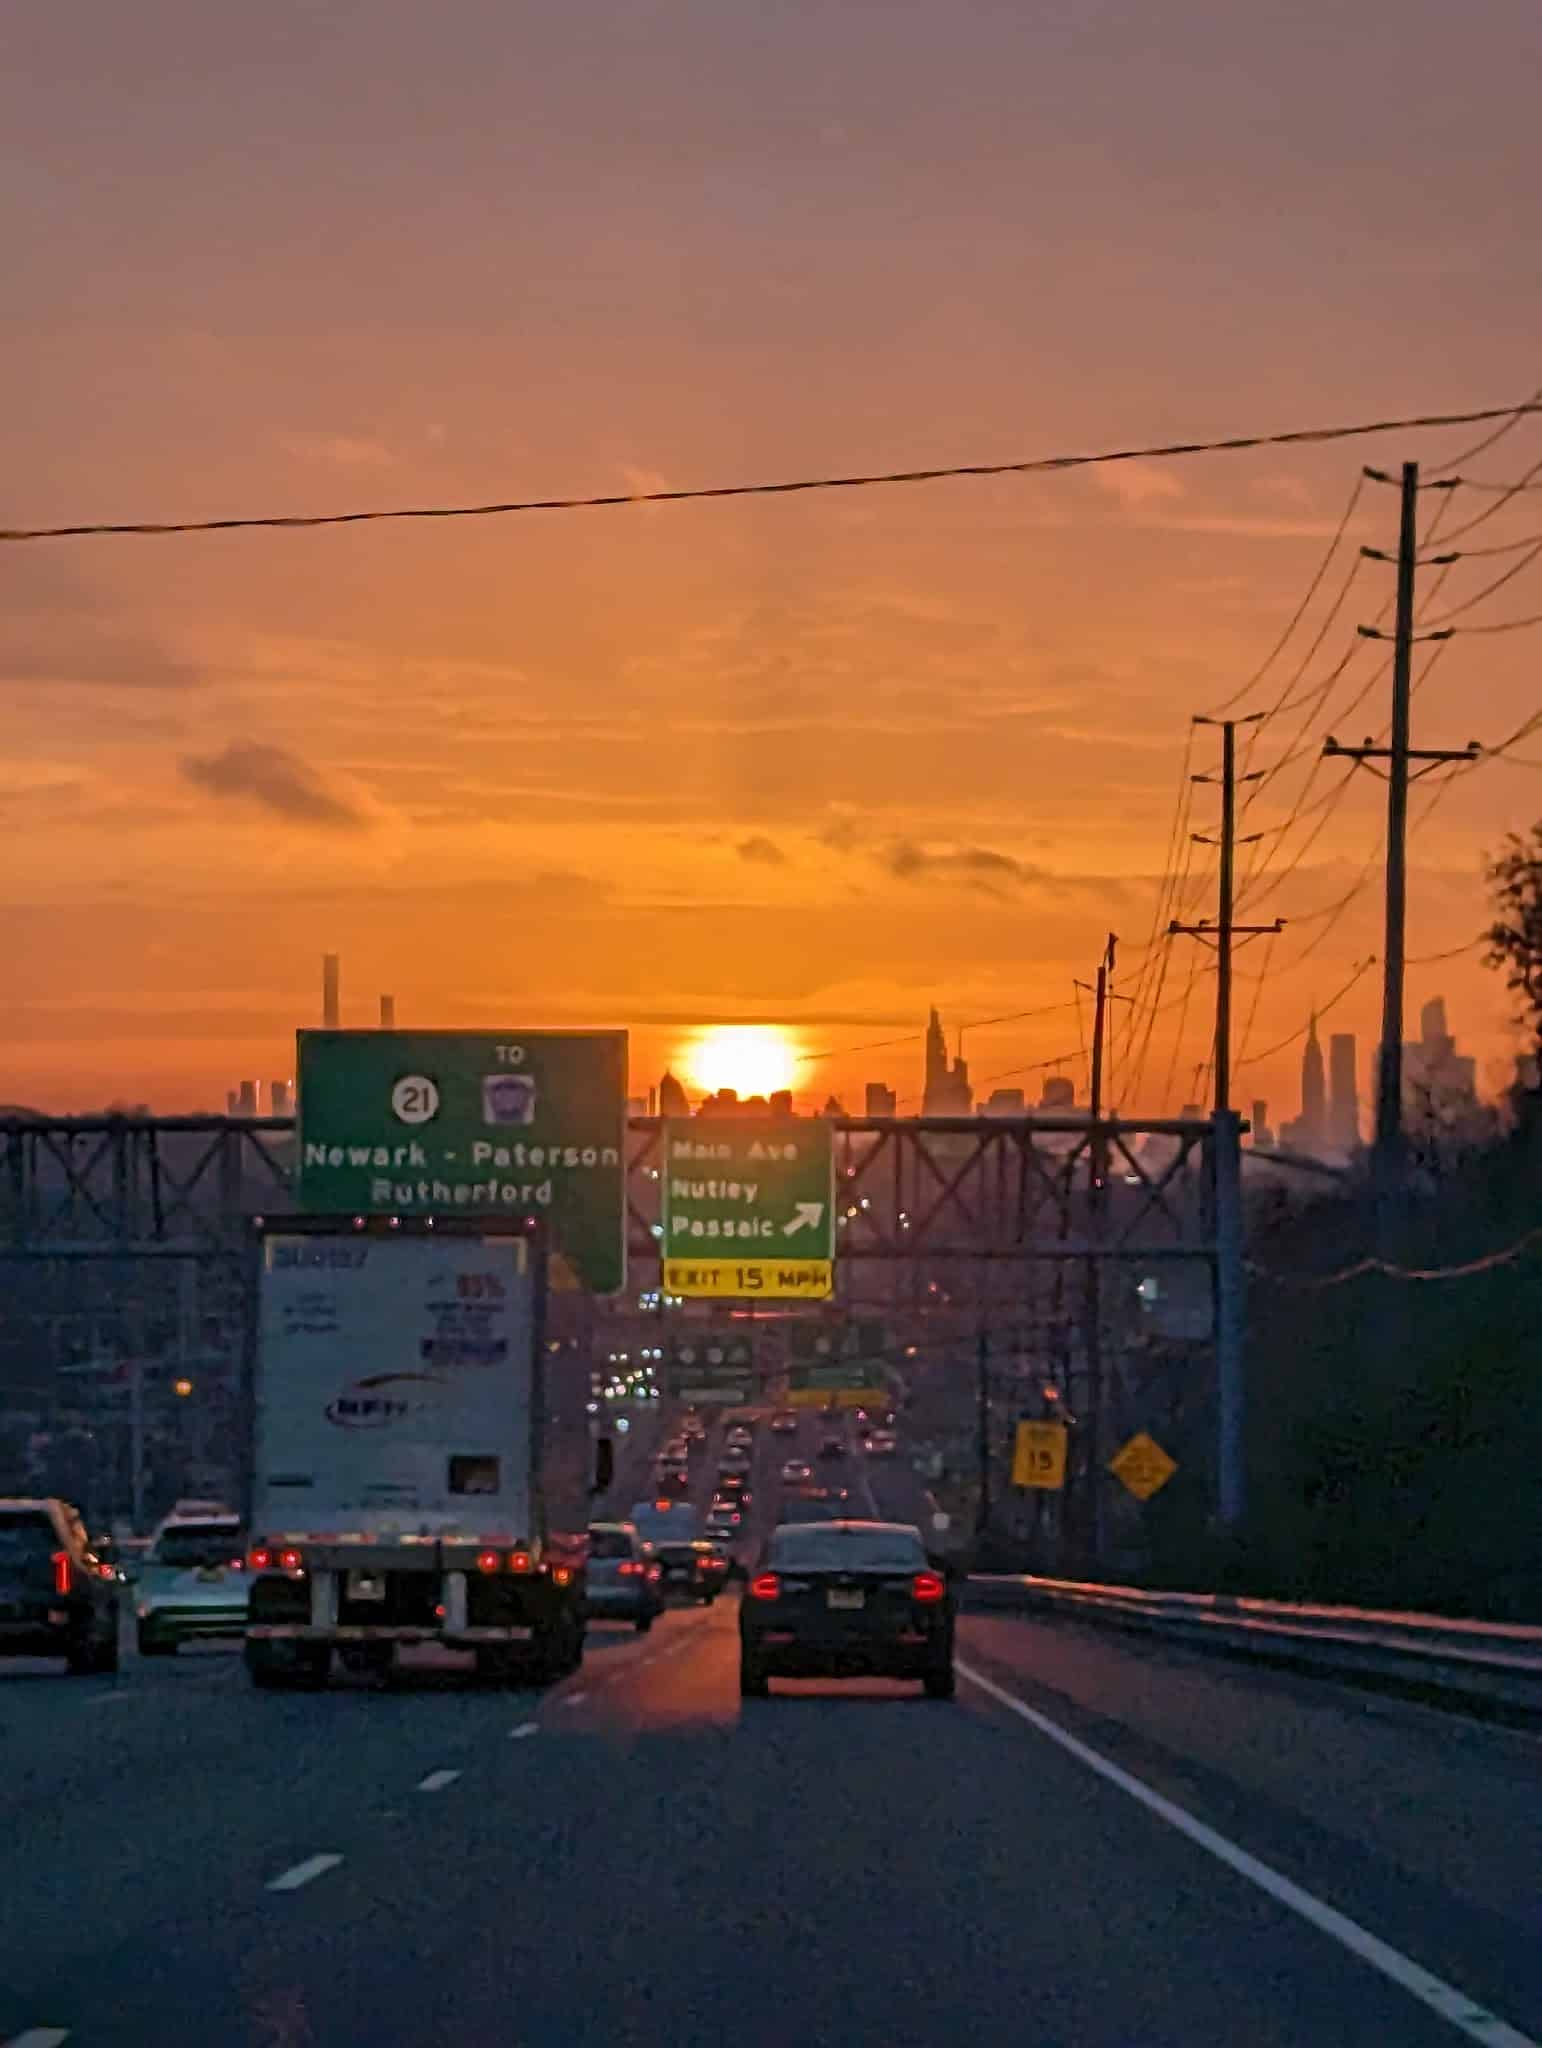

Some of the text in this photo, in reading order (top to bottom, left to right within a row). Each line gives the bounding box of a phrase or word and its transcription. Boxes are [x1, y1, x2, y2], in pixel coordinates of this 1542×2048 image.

[496, 1045, 525, 1065] TO
[402, 1086, 430, 1113] 21
[304, 1140, 426, 1167] Newark
[471, 1141, 619, 1168] Paterson
[748, 1140, 799, 1160] Ave
[371, 1178, 553, 1206] Rutherford
[671, 1179, 758, 1203] Nutley
[671, 1215, 775, 1237] Passaic
[669, 1267, 828, 1290] EXIT 15 MPH
